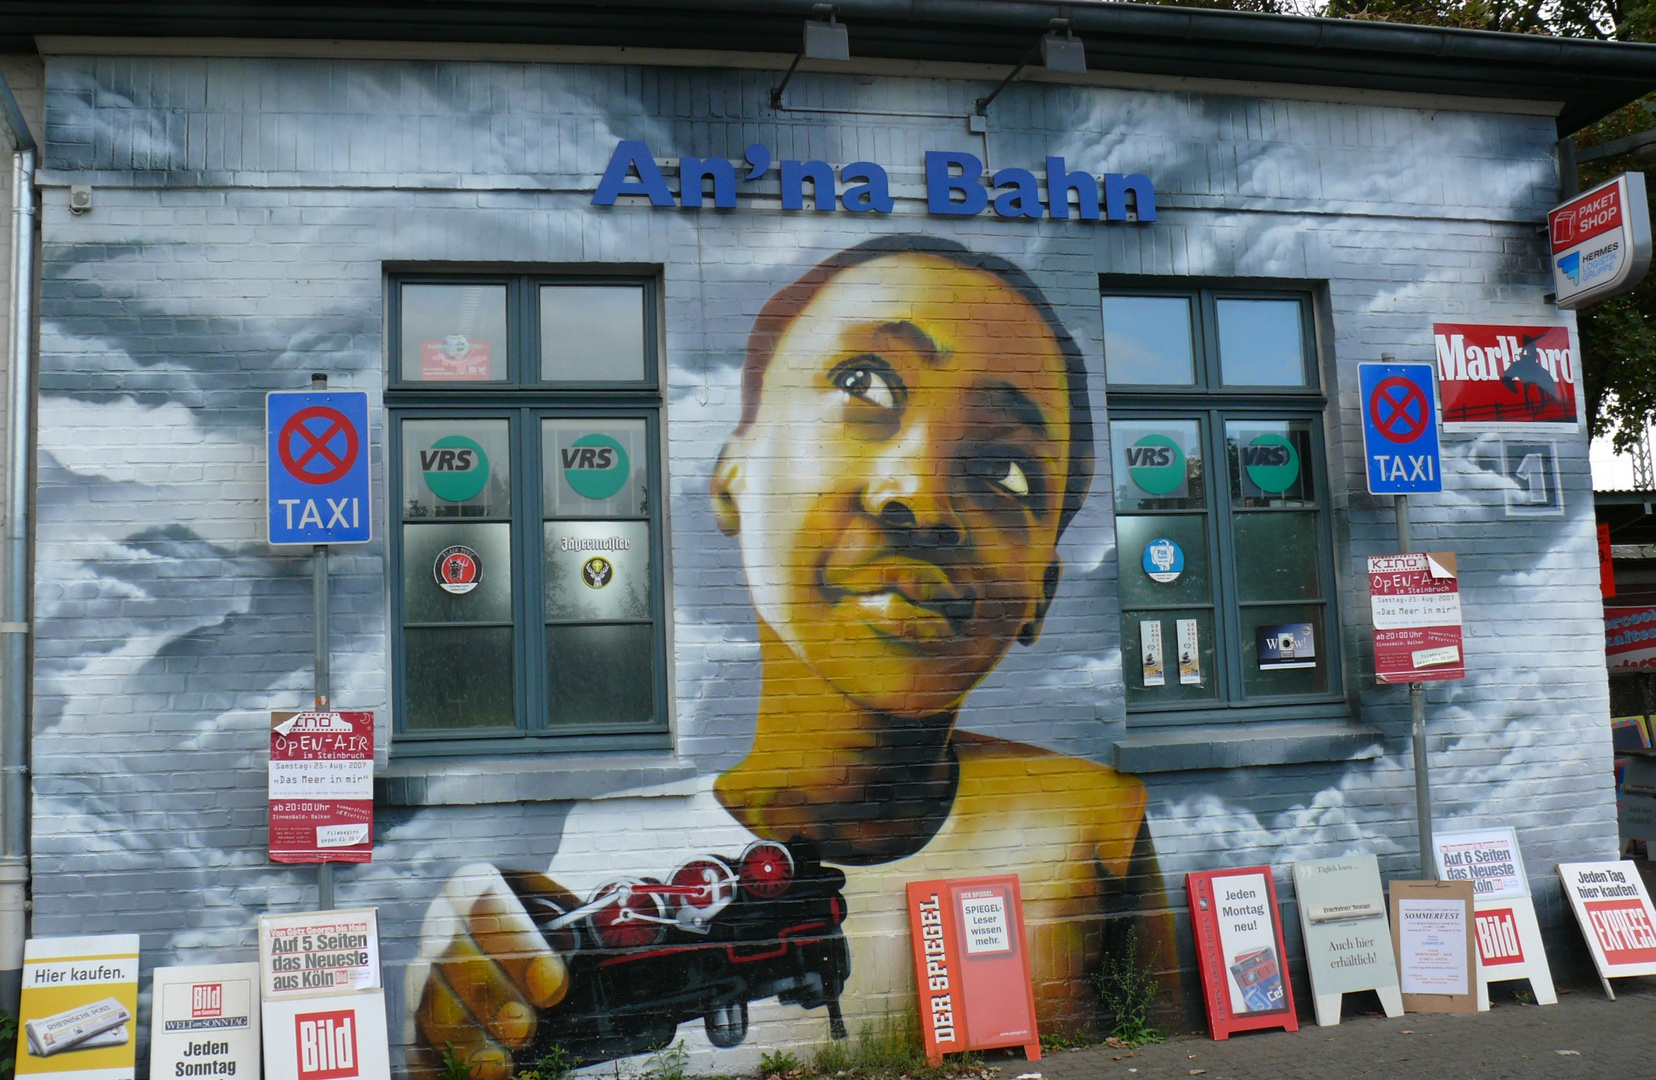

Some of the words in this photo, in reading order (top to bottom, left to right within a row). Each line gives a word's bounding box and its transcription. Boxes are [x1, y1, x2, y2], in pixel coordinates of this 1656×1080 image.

[590, 140, 894, 213] An'na
[925, 150, 1157, 222] Bahn
[1579, 192, 1616, 218] PAKET
[1580, 206, 1617, 233] SHOP
[1582, 242, 1619, 263] HERMES
[1582, 253, 1617, 272] LOGISTIK
[1583, 263, 1614, 281] GRUPPE
[420, 450, 472, 471] VRS
[561, 448, 613, 469] VRS
[1126, 448, 1170, 466] VRS
[1242, 447, 1286, 466] VRS
[1373, 454, 1434, 482] TAXI
[1516, 453, 1548, 503] 1
[278, 498, 359, 530] TAXI
[1399, 607, 1419, 615] Meer
[318, 751, 365, 759] Steinbruch
[330, 762, 347, 770] Aug.
[301, 775, 325, 784] Meer
[330, 775, 341, 783] in
[285, 803, 313, 811] 20:00
[314, 802, 330, 811] Uhr
[1444, 852, 1462, 866] Auf
[1464, 851, 1472, 864] 6
[1474, 848, 1511, 863] Seiten
[1317, 865, 1337, 873] Täglich
[1447, 867, 1467, 880] das
[1469, 863, 1515, 878] Neueste
[1578, 871, 1608, 884] Jeden
[1606, 870, 1626, 883] Tag
[1226, 890, 1256, 901] Jeden
[1577, 886, 1599, 899] hier
[1599, 884, 1639, 898] kaufen!
[965, 904, 1002, 914] SPIEGEL-
[1222, 904, 1265, 917] Montag
[973, 916, 997, 924] Leser
[1234, 920, 1258, 932] neu!
[270, 928, 286, 937] Von
[286, 928, 305, 936] Götz
[307, 926, 335, 935] George
[336, 924, 348, 932] bis
[971, 926, 1002, 935] wissen
[1475, 914, 1519, 960] Bild
[1590, 908, 1656, 951] EXPRESS
[271, 937, 299, 954] Auf
[302, 936, 313, 951] 5
[317, 933, 368, 949] Seiten
[919, 893, 949, 991] SPIEGEL
[975, 936, 1000, 945] mehr.
[1328, 938, 1354, 951] Auch
[1355, 937, 1375, 949] hier
[272, 955, 301, 971] das
[304, 950, 368, 969] Neueste
[1330, 953, 1377, 969] erhältlich!
[35, 969, 66, 983] Hier
[70, 966, 125, 981] kaufen.
[273, 975, 299, 990] aus
[302, 970, 333, 987] Köln
[193, 985, 220, 1010] Bild
[46, 1011, 93, 1031] RHEINISCHE
[91, 1005, 111, 1016] POST
[166, 1021, 193, 1030] WELT
[202, 1017, 247, 1028] SONNTAG
[931, 993, 956, 1044] DER
[183, 1040, 229, 1057] Jeden
[300, 1017, 354, 1073] Bild
[175, 1060, 236, 1077] Sonntag
